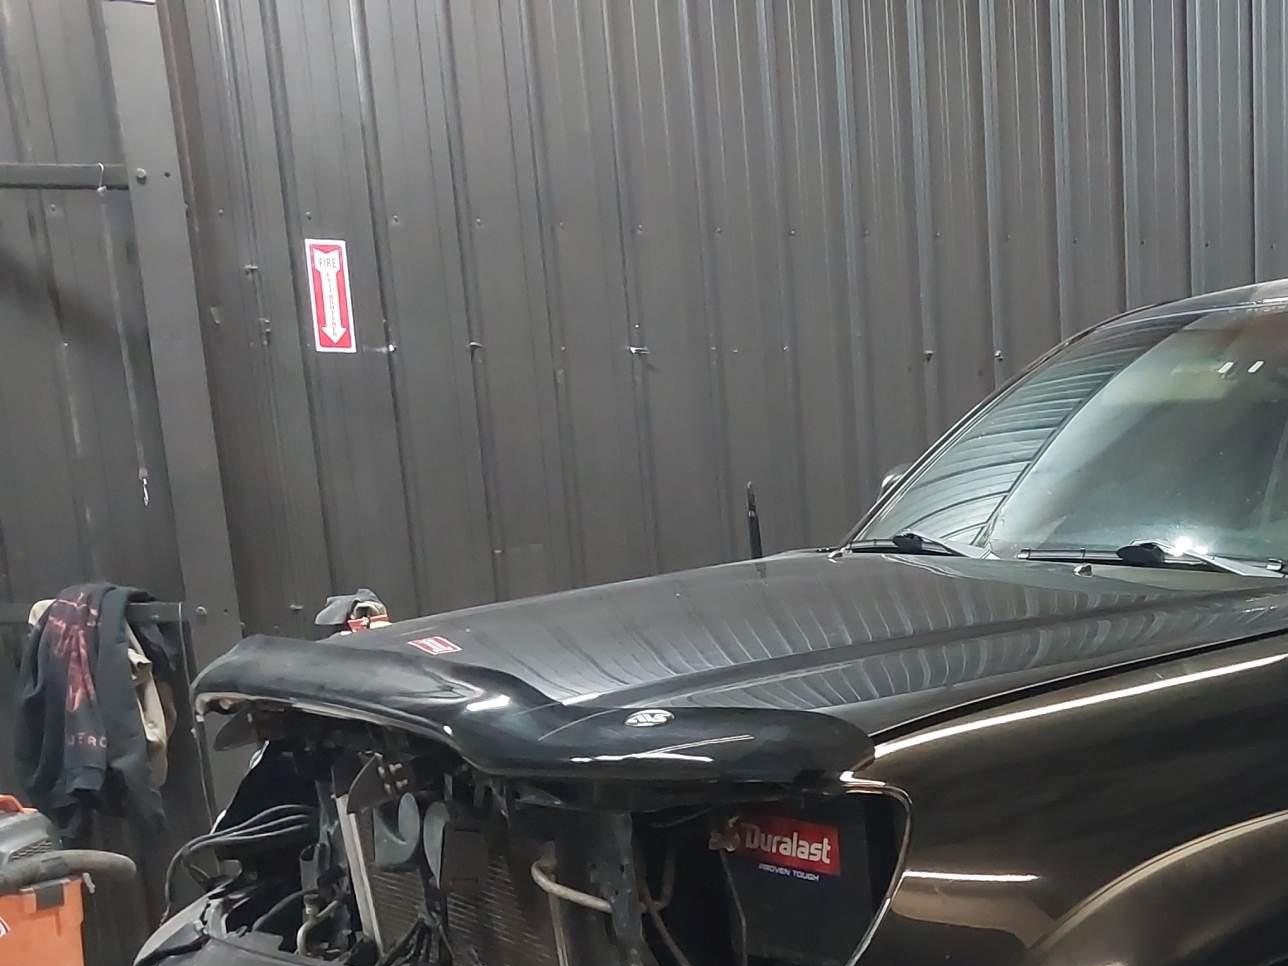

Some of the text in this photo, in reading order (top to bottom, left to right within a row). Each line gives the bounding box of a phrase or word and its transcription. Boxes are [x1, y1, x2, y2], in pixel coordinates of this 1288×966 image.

[319, 257, 337, 269] FIRE
[745, 823, 832, 864] Duralast
[758, 863, 820, 882] PROVEN TOUGH
